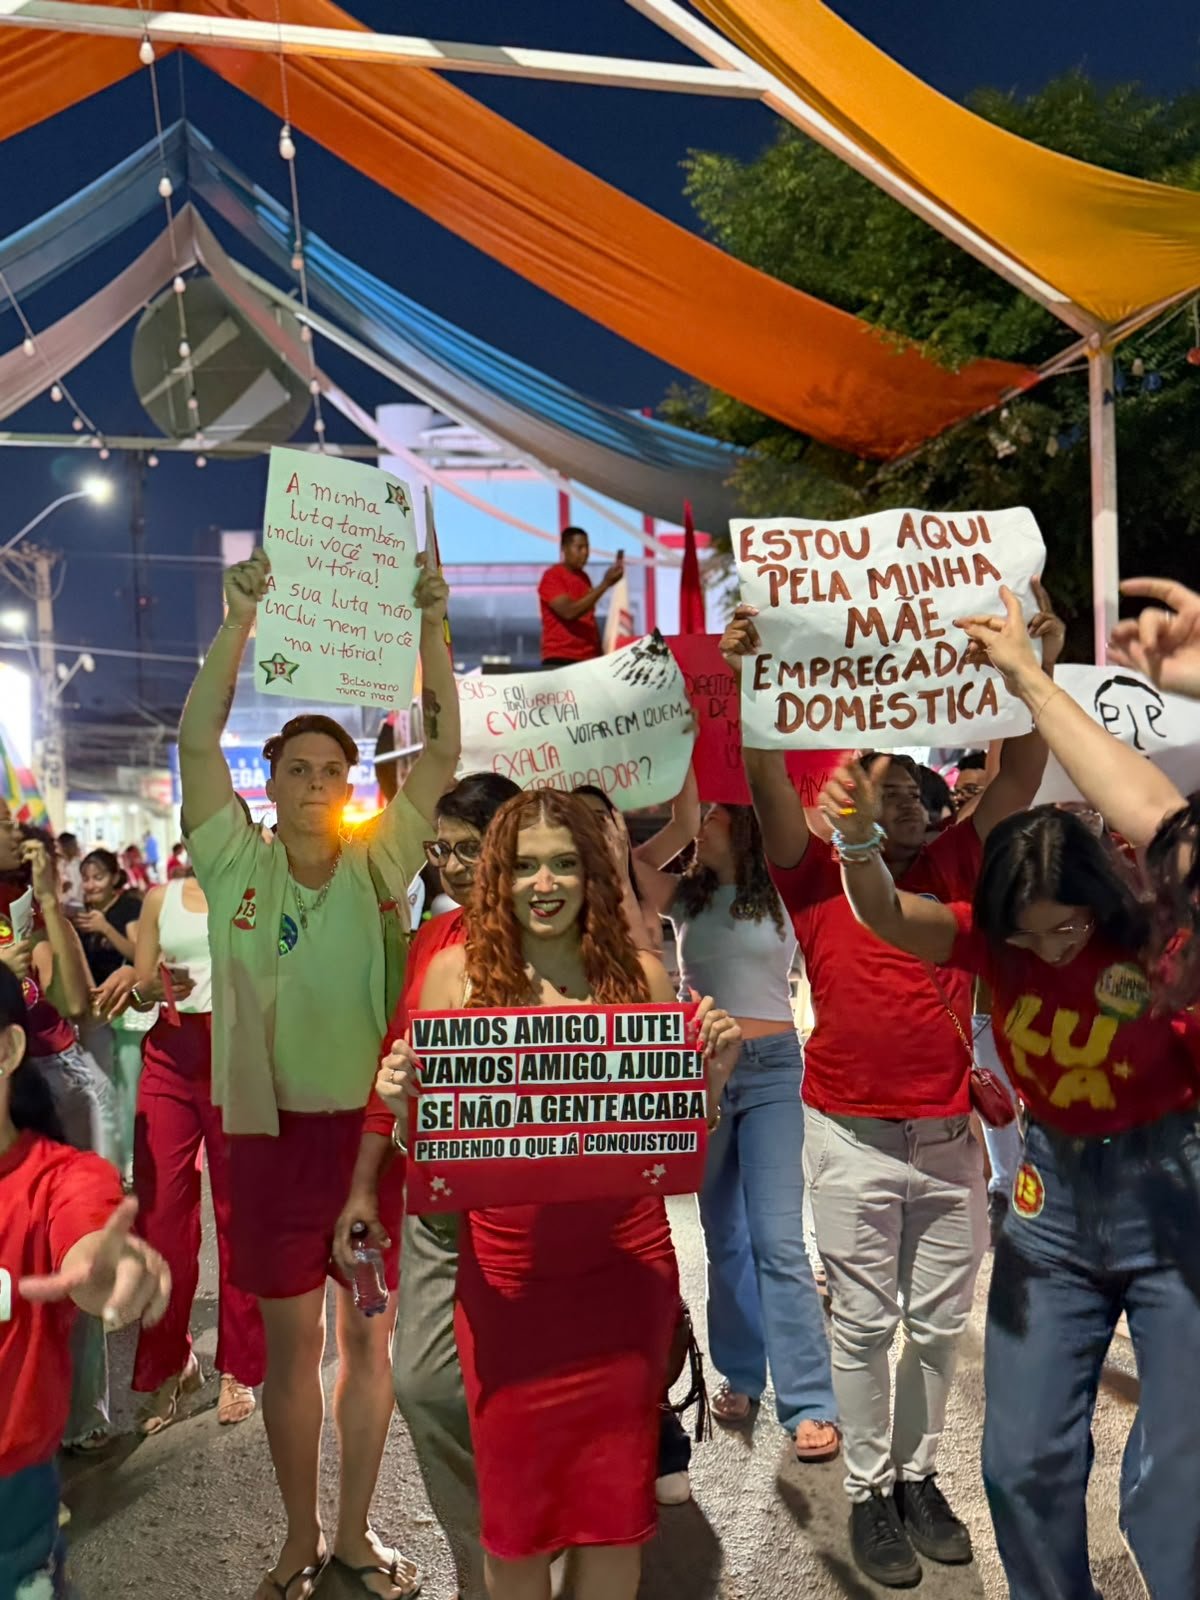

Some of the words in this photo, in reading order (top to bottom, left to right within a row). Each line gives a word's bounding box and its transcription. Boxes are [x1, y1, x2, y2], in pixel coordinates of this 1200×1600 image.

[286, 472, 299, 495] A
[311, 483, 381, 515] minha
[337, 514, 405, 551] também
[740, 525, 870, 563] ESTOU
[896, 512, 992, 551] AQUI
[320, 536, 363, 560] você
[372, 552, 399, 568] na
[307, 555, 379, 589] vitória!
[757, 563, 852, 608] PELA
[867, 552, 1001, 600] MINHA
[266, 575, 276, 591] A
[289, 583, 322, 604] sua
[378, 602, 412, 621] não
[323, 618, 367, 640] nem
[374, 631, 413, 647] você
[845, 595, 946, 648] MÃE
[284, 636, 312, 652] na
[320, 643, 383, 666] vitória!
[273, 662, 286, 675] 13
[336, 687, 366, 698] nunca
[504, 685, 525, 701] FOI
[774, 677, 998, 734] DOMÉSTICA
[486, 711, 504, 736] E
[554, 702, 580, 723] VAI
[566, 721, 614, 745] VOTAR
[615, 711, 640, 735] EM
[243, 901, 256, 918] 13
[413, 1016, 508, 1047] VAMOS
[514, 1014, 606, 1045] AMIGO,
[614, 1013, 681, 1043] LUTE!
[420, 1055, 513, 1085] VAMOS
[520, 1053, 612, 1083] AMIGO,
[618, 1051, 703, 1080] AJUDE!
[421, 1100, 453, 1130] SE
[459, 1095, 513, 1129] NÃO
[516, 1096, 534, 1123] A
[540, 1094, 618, 1123] GENTE
[620, 1091, 705, 1120] ACABA
[416, 1138, 502, 1160] PERDENDO
[509, 1138, 520, 1157] O
[525, 1136, 557, 1158] QUE
[560, 1133, 579, 1156] JÁ
[584, 1132, 696, 1154] CONQUISTOU!
[1017, 1170, 1037, 1204] 13
